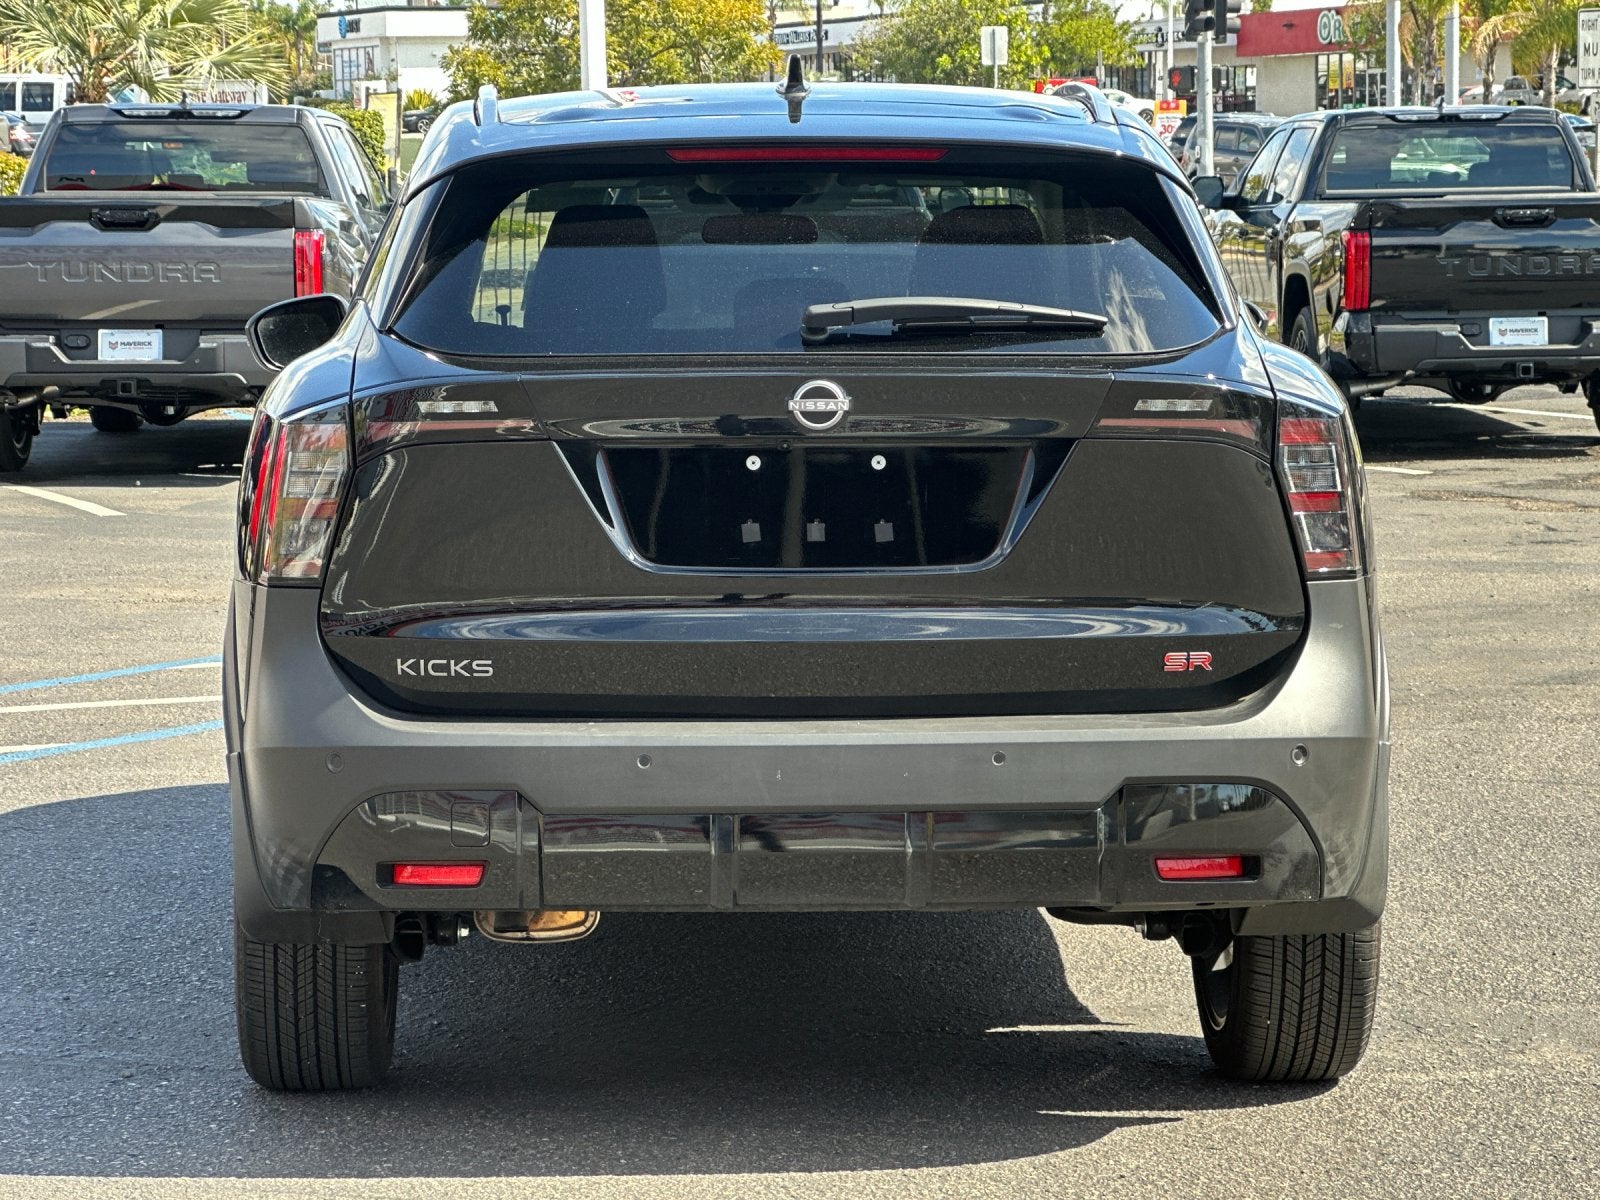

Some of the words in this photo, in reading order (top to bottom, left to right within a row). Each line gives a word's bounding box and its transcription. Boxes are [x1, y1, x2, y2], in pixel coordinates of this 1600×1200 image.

[1581, 18, 1599, 31] RIGHT
[1583, 42, 1599, 57] MU
[1581, 68, 1596, 81] TURN
[27, 260, 221, 283] TUNDRA
[789, 401, 848, 410] NISSAN
[396, 658, 494, 677] KICKS
[1163, 651, 1213, 672] SR
